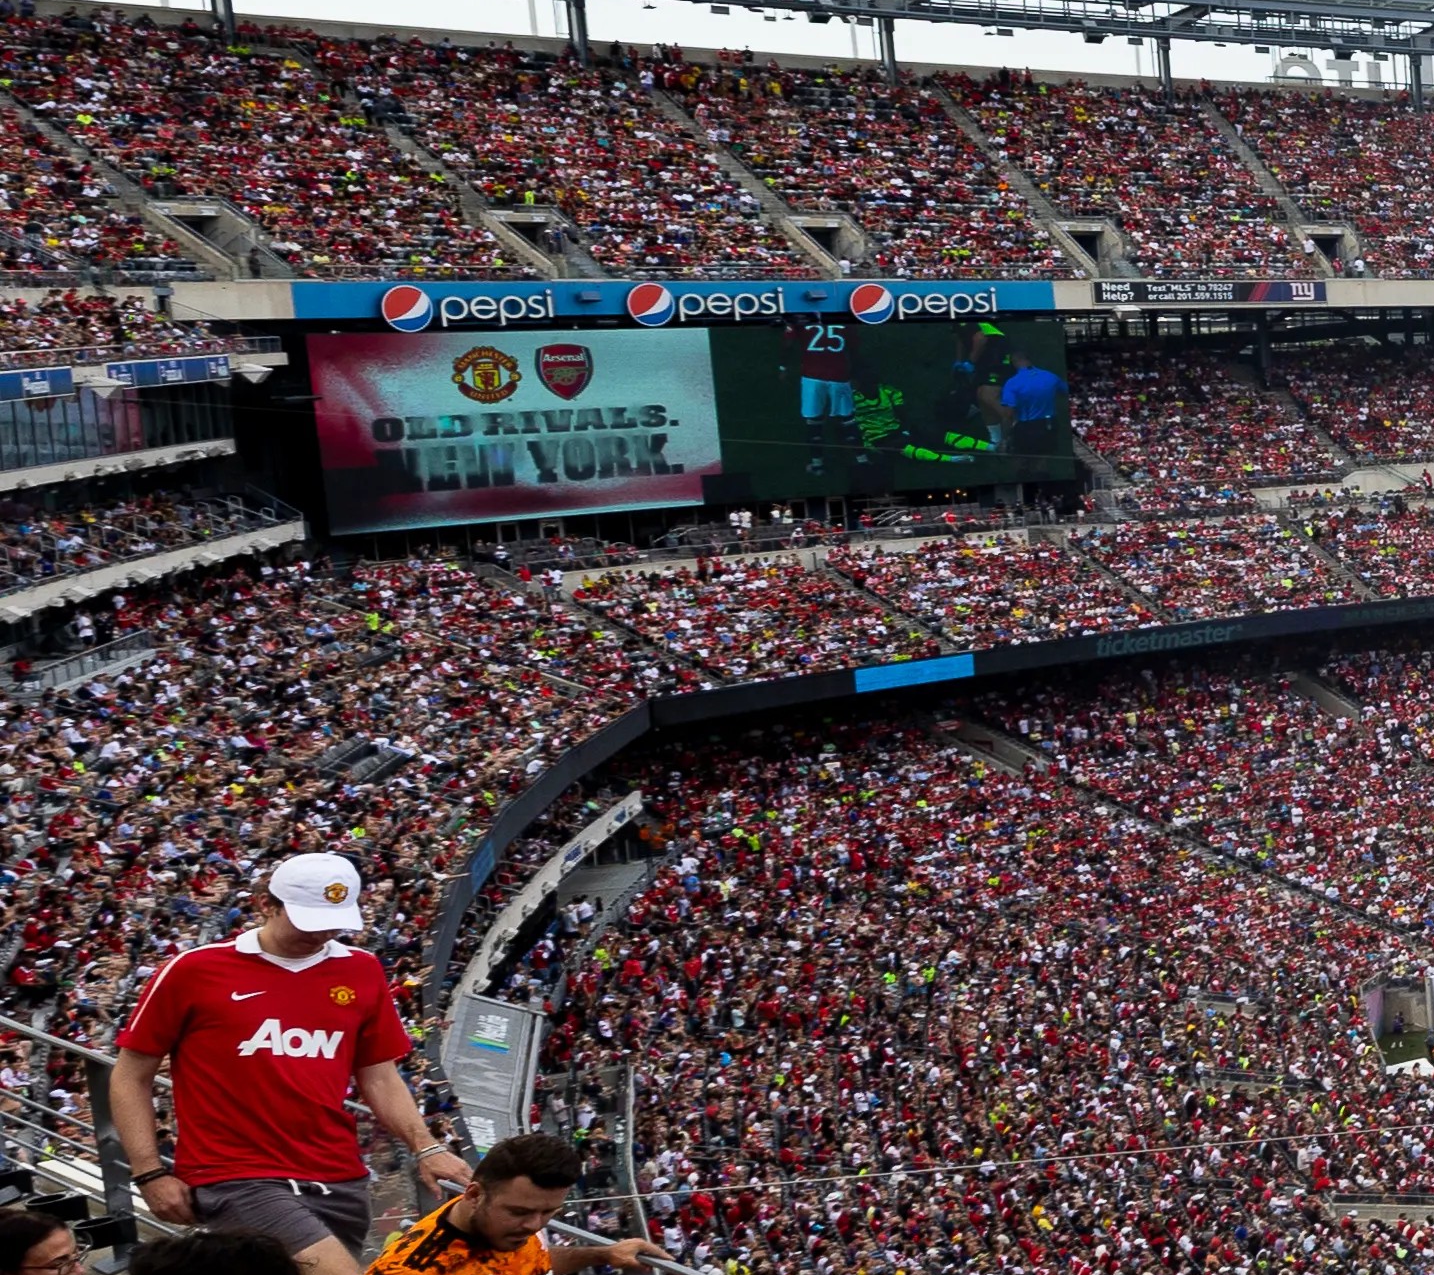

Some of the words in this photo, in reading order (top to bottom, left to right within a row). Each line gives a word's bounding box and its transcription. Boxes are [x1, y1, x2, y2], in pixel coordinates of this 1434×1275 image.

[679, 286, 786, 322] pepsi
[898, 287, 998, 321] pepsi
[1102, 283, 1131, 292] Need
[1102, 292, 1134, 302] Help?
[441, 288, 555, 327] pepsi
[805, 325, 846, 351] 25
[543, 353, 585, 364] Arsenal
[371, 413, 474, 444] OLD
[485, 403, 680, 437] RIVALS.
[527, 433, 685, 484] YORK.
